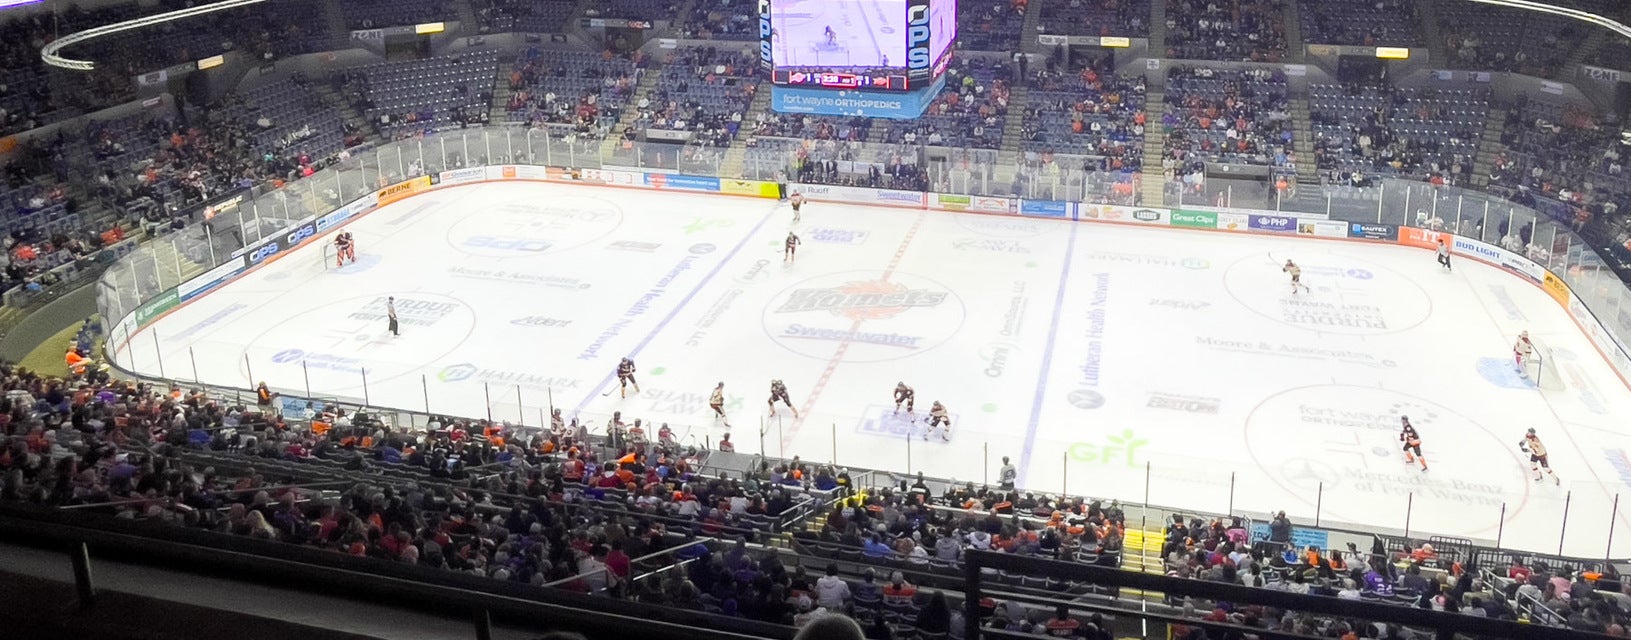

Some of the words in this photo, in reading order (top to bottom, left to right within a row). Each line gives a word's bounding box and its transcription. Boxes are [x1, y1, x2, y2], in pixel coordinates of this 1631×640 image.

[758, 0, 771, 61] OPS
[908, 5, 929, 68] OPS
[1583, 66, 1620, 81] ZONE
[783, 94, 801, 104] fort
[801, 96, 834, 106] wayne
[834, 100, 901, 109] ORTHOPEDICS
[387, 182, 411, 196] BERNE
[807, 186, 830, 195] Ruoff
[877, 190, 921, 202] Sweetwater
[1172, 212, 1195, 223] Great
[1196, 215, 1214, 224] Clips
[1270, 218, 1288, 227] PHP
[287, 225, 314, 244] OPS
[249, 242, 278, 262] OPS
[1456, 240, 1474, 252] BUD
[1475, 246, 1501, 259] LIGHT
[657, 254, 701, 288] Lutheran
[1089, 271, 1110, 307] Network
[624, 288, 664, 317] Health
[783, 323, 927, 345] Sweetwater
[1084, 309, 1106, 341] Health
[577, 318, 633, 360] Network
[1195, 335, 1255, 351] Moore
[1257, 341, 1273, 351] &
[983, 346, 1009, 379] Omni
[1078, 340, 1102, 388] Lutheran
[475, 367, 584, 390] HALLMARK
[648, 401, 704, 416] LAW
[1344, 466, 1503, 495] Mercedes-Benz
[1354, 481, 1367, 493] of
[1374, 483, 1425, 499] Fort
[1431, 488, 1503, 507] Wayne
